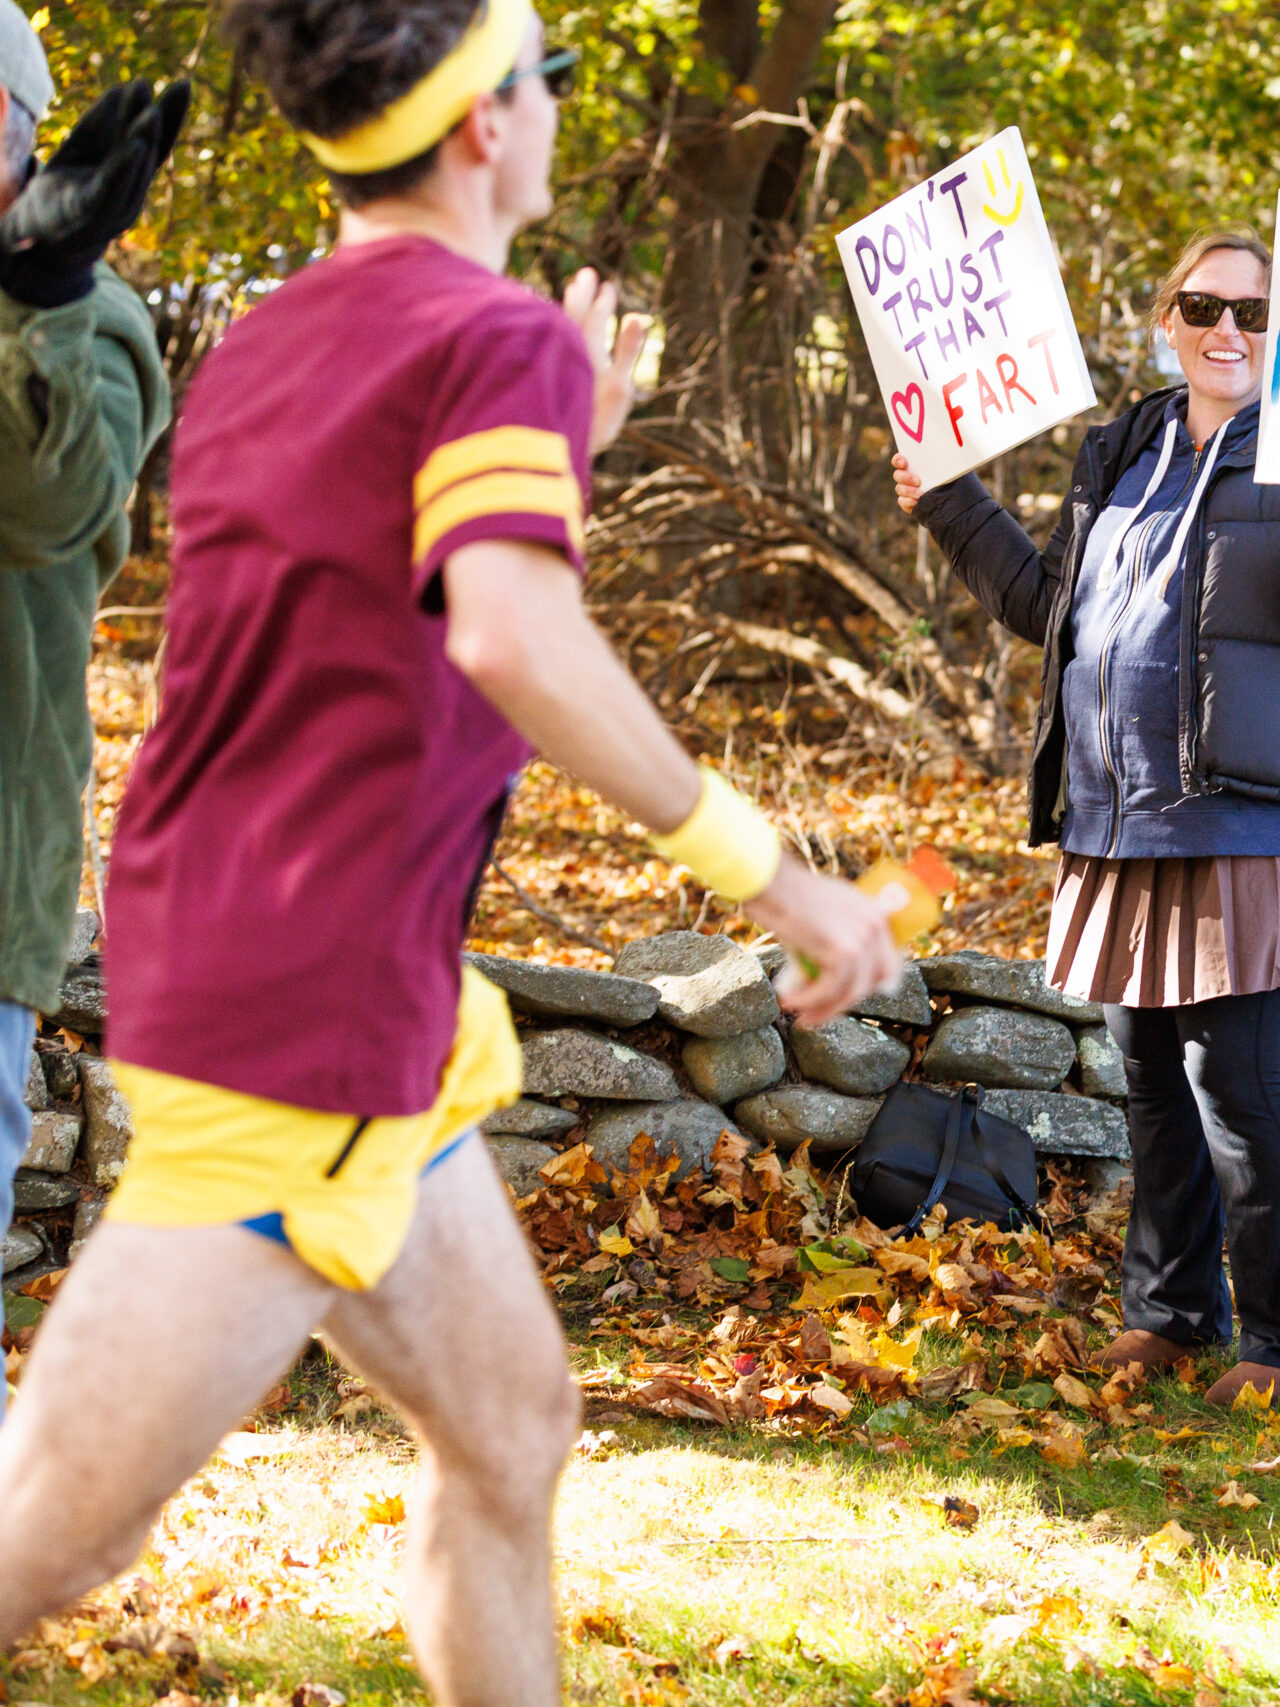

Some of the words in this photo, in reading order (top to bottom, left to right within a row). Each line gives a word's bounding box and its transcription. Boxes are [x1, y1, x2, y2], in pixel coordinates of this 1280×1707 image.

[855, 172, 968, 296] DON'T
[882, 229, 1004, 338] TRUST
[904, 289, 1012, 381] THAT
[942, 328, 1060, 448] FART
